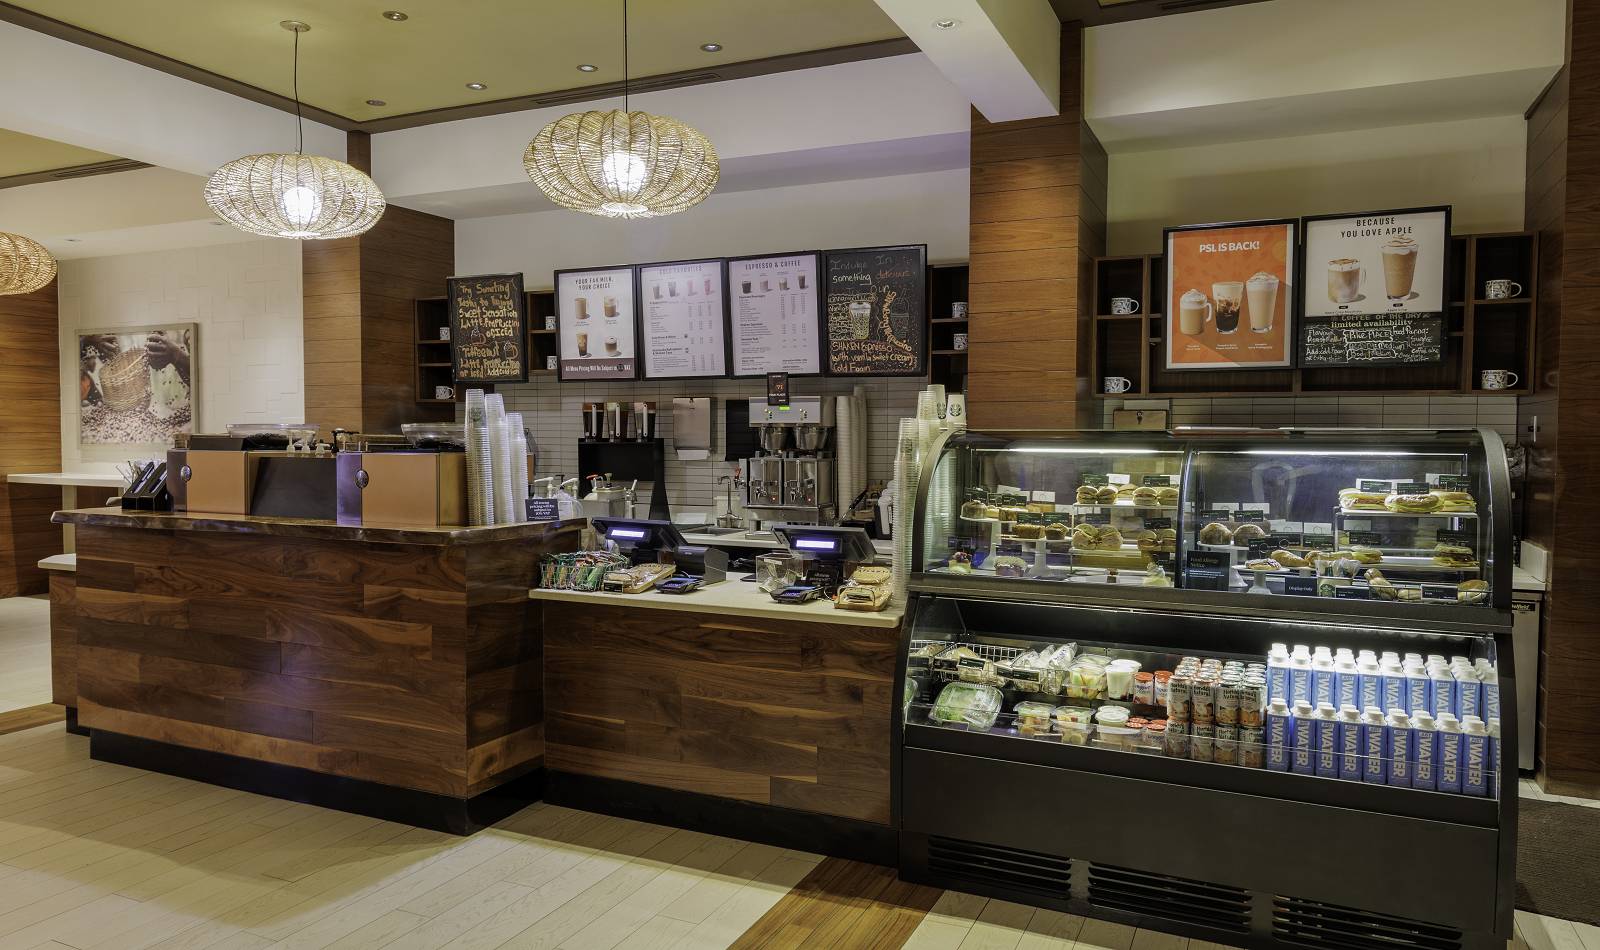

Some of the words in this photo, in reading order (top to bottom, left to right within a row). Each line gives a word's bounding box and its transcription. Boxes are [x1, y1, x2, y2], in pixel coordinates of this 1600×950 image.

[1341, 230, 1358, 238] YOU
[1361, 228, 1382, 237] LOVE
[1385, 226, 1413, 235] APPLE
[1356, 217, 1395, 227] BECAUSE
[745, 262, 773, 270] ESPRESSO
[1200, 244, 1216, 253] PSL
[1218, 242, 1228, 252] IS
[1229, 241, 1260, 251] BACK!
[832, 272, 872, 286] something
[1331, 320, 1361, 328] limited
[1363, 319, 1413, 328] availability
[1271, 719, 1284, 763] WATER
[1297, 722, 1309, 766] WATER
[1321, 727, 1333, 769] WATER
[1345, 729, 1357, 772] WATER
[1369, 731, 1381, 774] WATER
[1393, 735, 1406, 777] WATER
[1418, 737, 1431, 780] WATER
[1444, 739, 1457, 782] WATER
[1469, 742, 1482, 785] WATER
